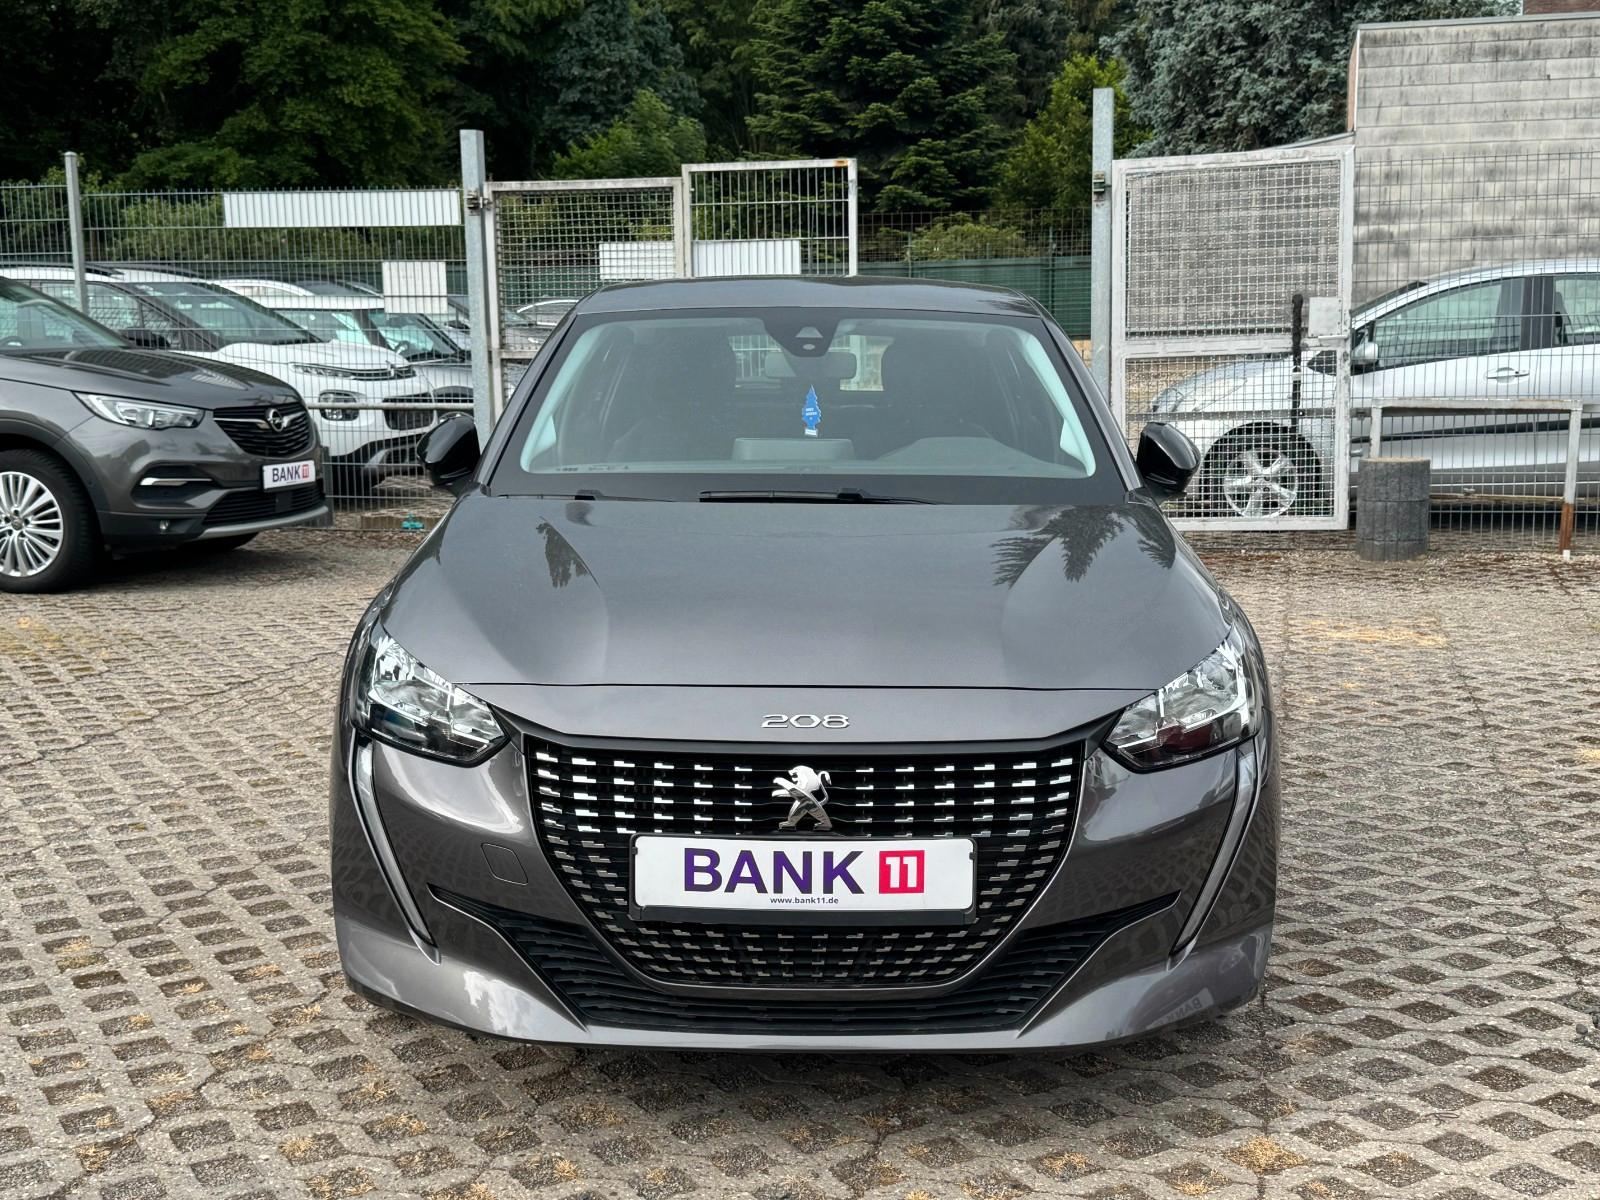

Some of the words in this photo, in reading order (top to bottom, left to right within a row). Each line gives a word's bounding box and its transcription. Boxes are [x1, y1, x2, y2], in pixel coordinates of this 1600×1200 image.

[272, 465, 301, 482] BANK
[761, 714, 850, 728] 208
[684, 848, 865, 894] BANK
[883, 854, 920, 890] 11
[770, 896, 839, 904] www.bank11.de
